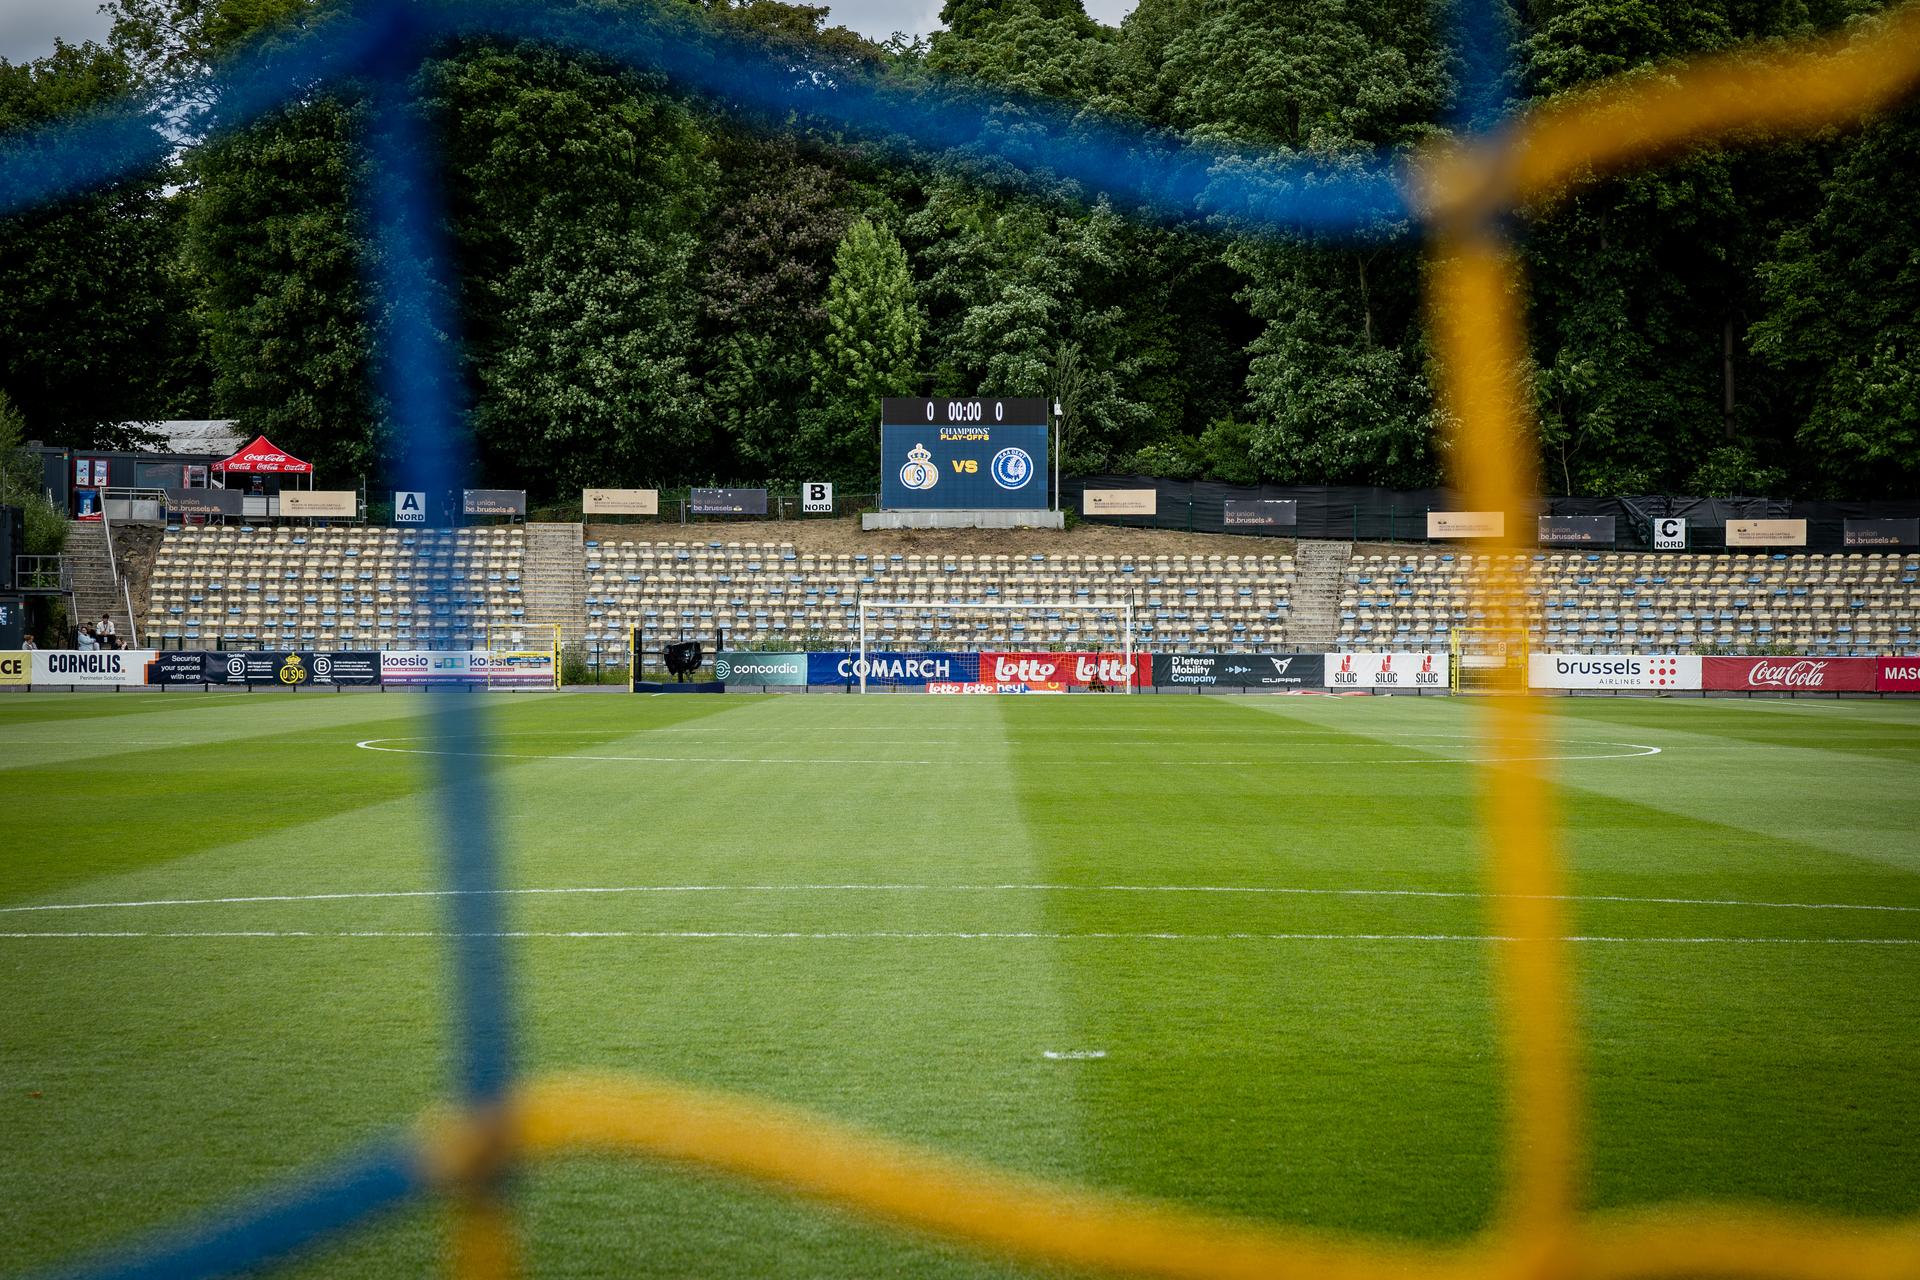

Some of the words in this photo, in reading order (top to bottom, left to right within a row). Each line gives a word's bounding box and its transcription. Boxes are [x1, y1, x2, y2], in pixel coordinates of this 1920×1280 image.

[926, 401, 934, 421] 0
[948, 401, 982, 421] 00:00
[995, 401, 1003, 421] 0
[952, 460, 978, 473] VS
[810, 484, 826, 501] B
[402, 494, 420, 511] A
[1661, 519, 1678, 538] C
[1656, 541, 1684, 549] NORD
[171, 655, 200, 663] Securing
[382, 654, 428, 666] koesio
[733, 662, 798, 674] concordia
[837, 659, 950, 678] COMARCH
[1171, 665, 1210, 675] Mobility
[1556, 658, 1641, 675] brussels
[1749, 660, 1829, 686] Coca-Cola
[1171, 674, 1217, 684] Company
[1885, 667, 1920, 680] MAS
[996, 682, 1025, 693] hey!
